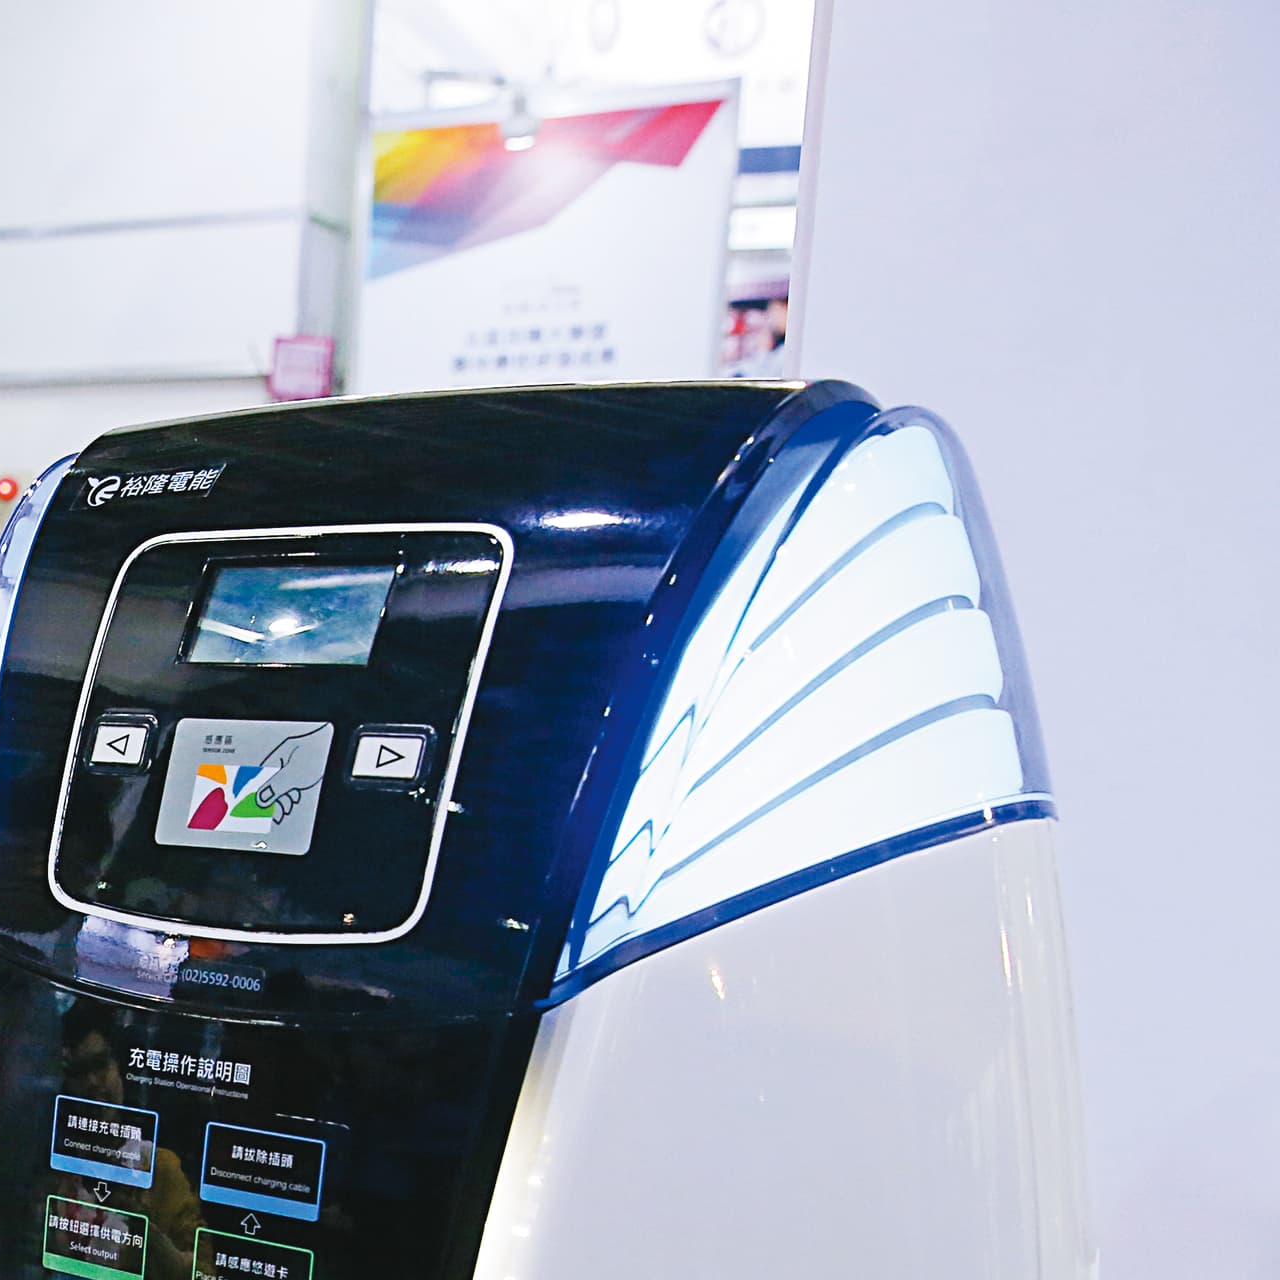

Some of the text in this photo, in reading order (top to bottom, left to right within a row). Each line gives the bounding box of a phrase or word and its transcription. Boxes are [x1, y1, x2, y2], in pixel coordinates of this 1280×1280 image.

[120, 468, 220, 498] 裕隆電能
[128, 1048, 252, 1086] 充電操作說明圖
[67, 1115, 142, 1142] 請連接充電插頭
[64, 1138, 91, 1151] Connect
[231, 1145, 294, 1169] 請拔除插頭
[210, 1166, 311, 1194] Disconnect charging cable
[70, 1241, 118, 1262] Select output
[215, 1252, 289, 1280] 請感應悠遊卡
